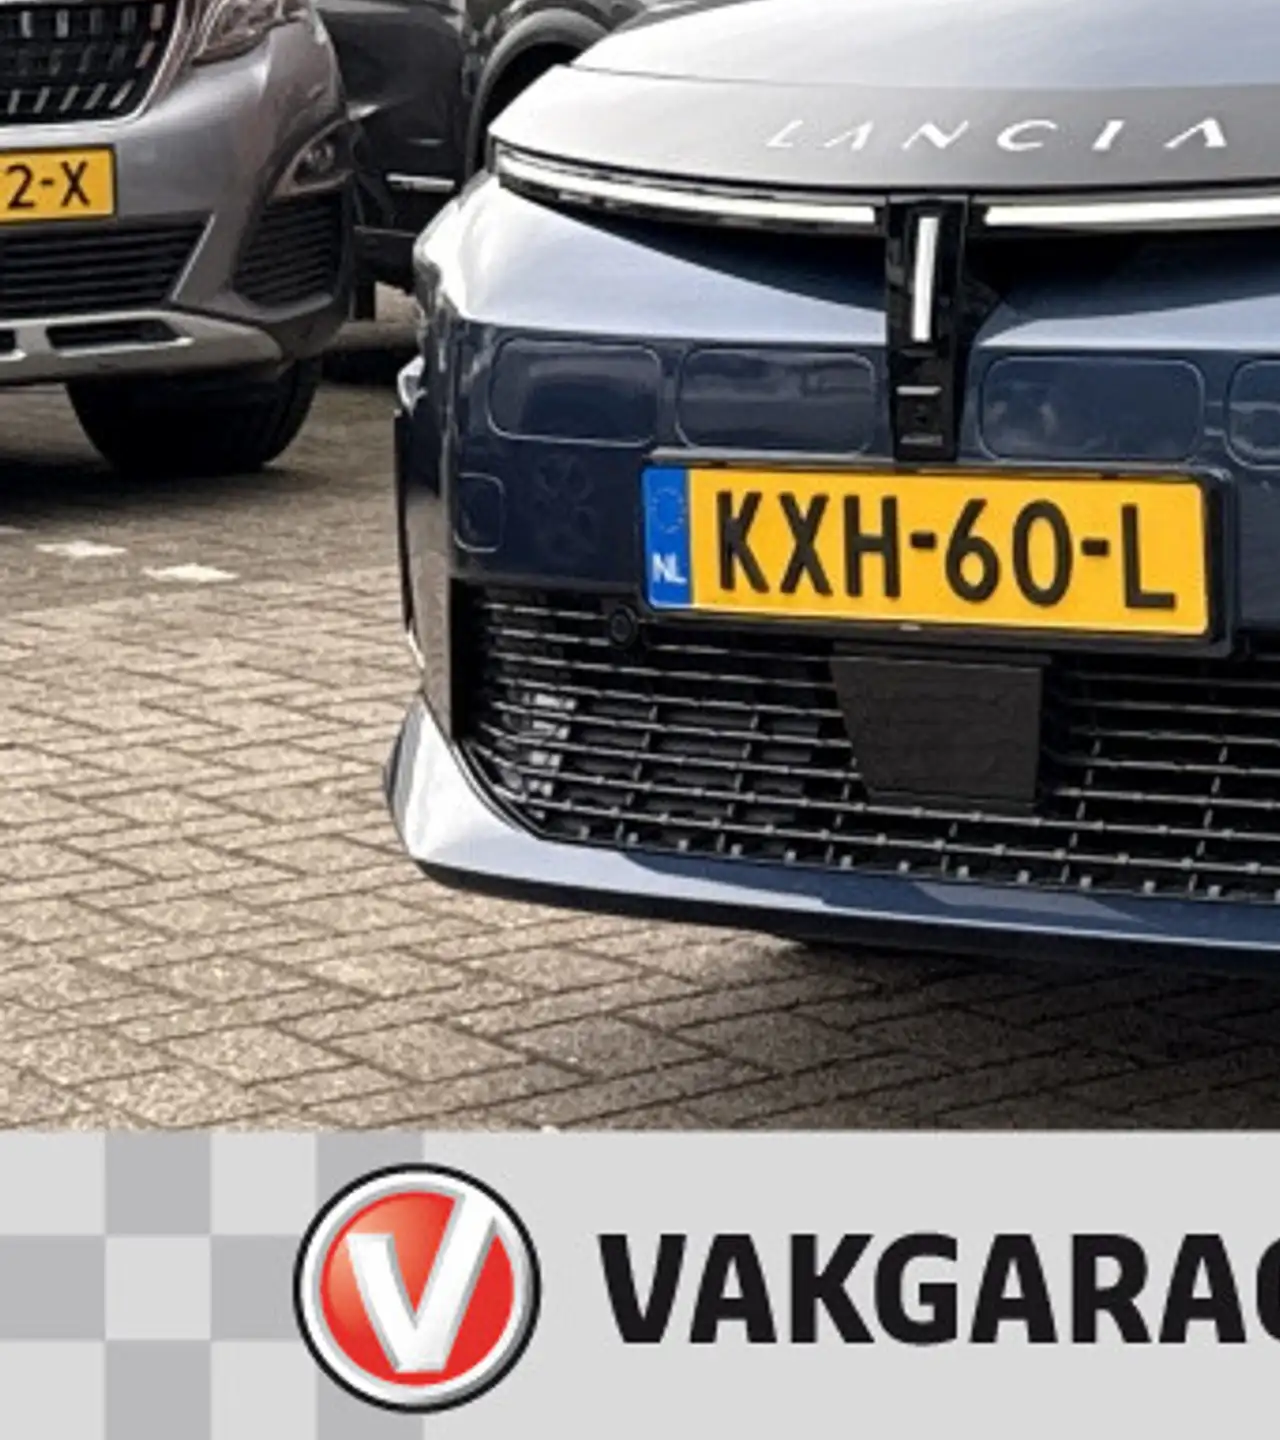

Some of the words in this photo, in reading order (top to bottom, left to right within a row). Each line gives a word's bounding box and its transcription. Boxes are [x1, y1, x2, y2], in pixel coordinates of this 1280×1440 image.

[765, 117, 1228, 151] LANCIA
[716, 490, 1177, 611] KXH-60-L
[652, 552, 687, 584] NL
